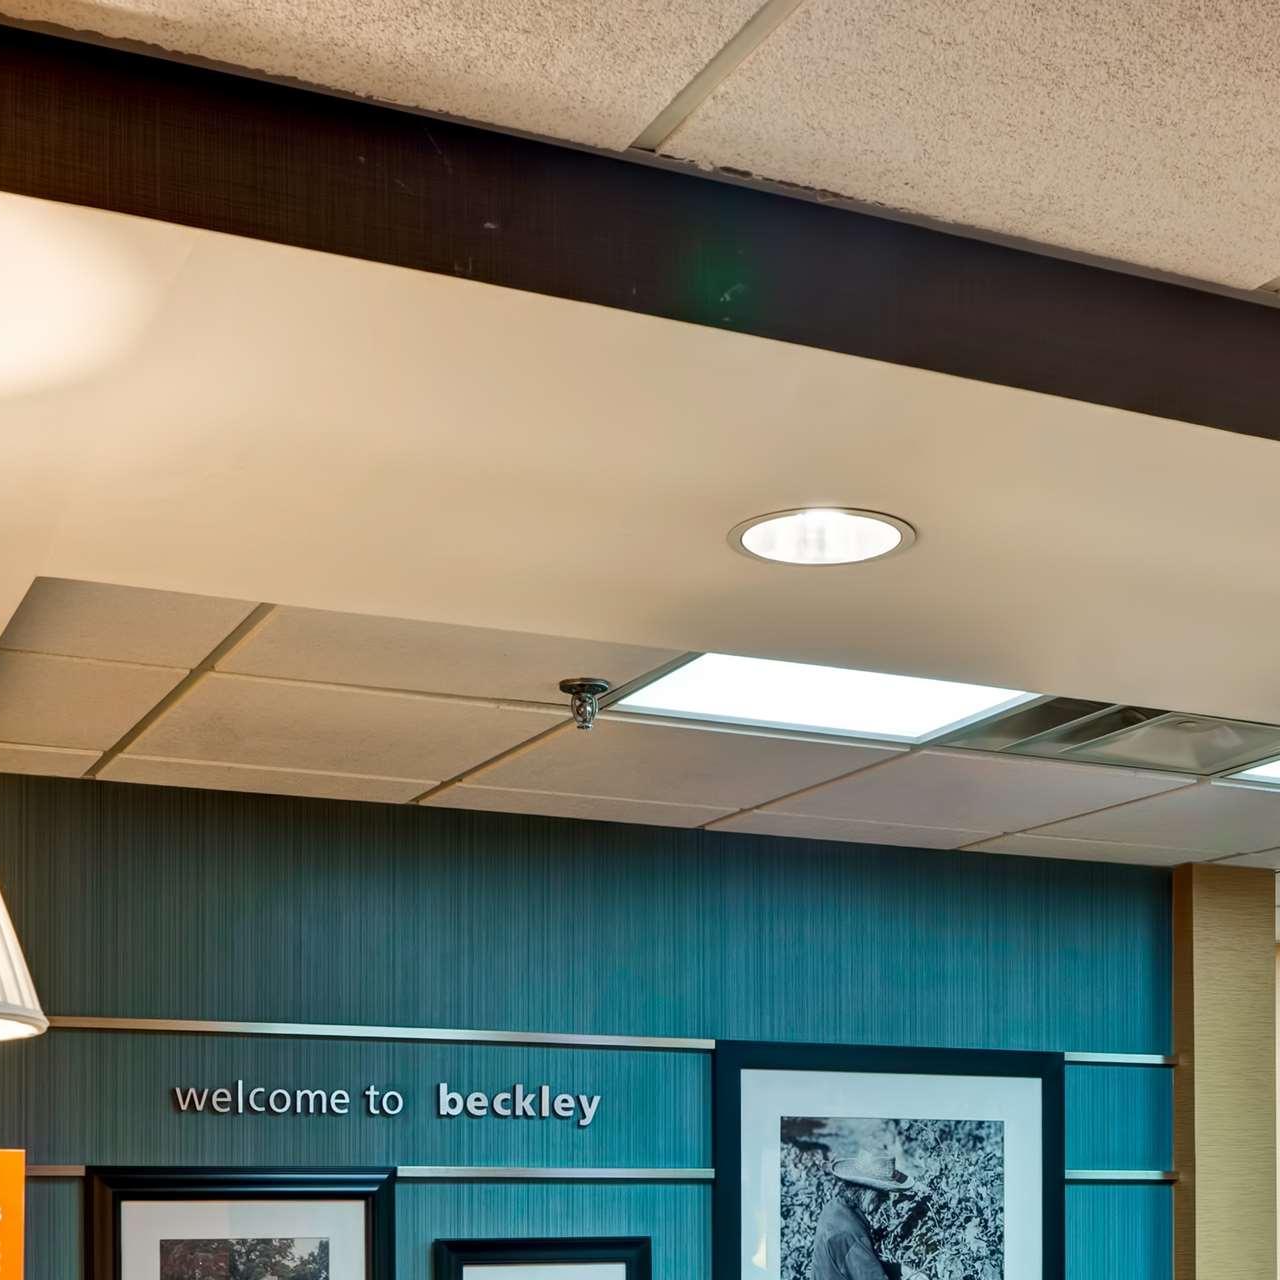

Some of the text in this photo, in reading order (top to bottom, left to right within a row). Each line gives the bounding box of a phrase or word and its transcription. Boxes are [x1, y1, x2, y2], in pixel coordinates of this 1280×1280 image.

[175, 1080, 601, 1126] welcome to beckley
